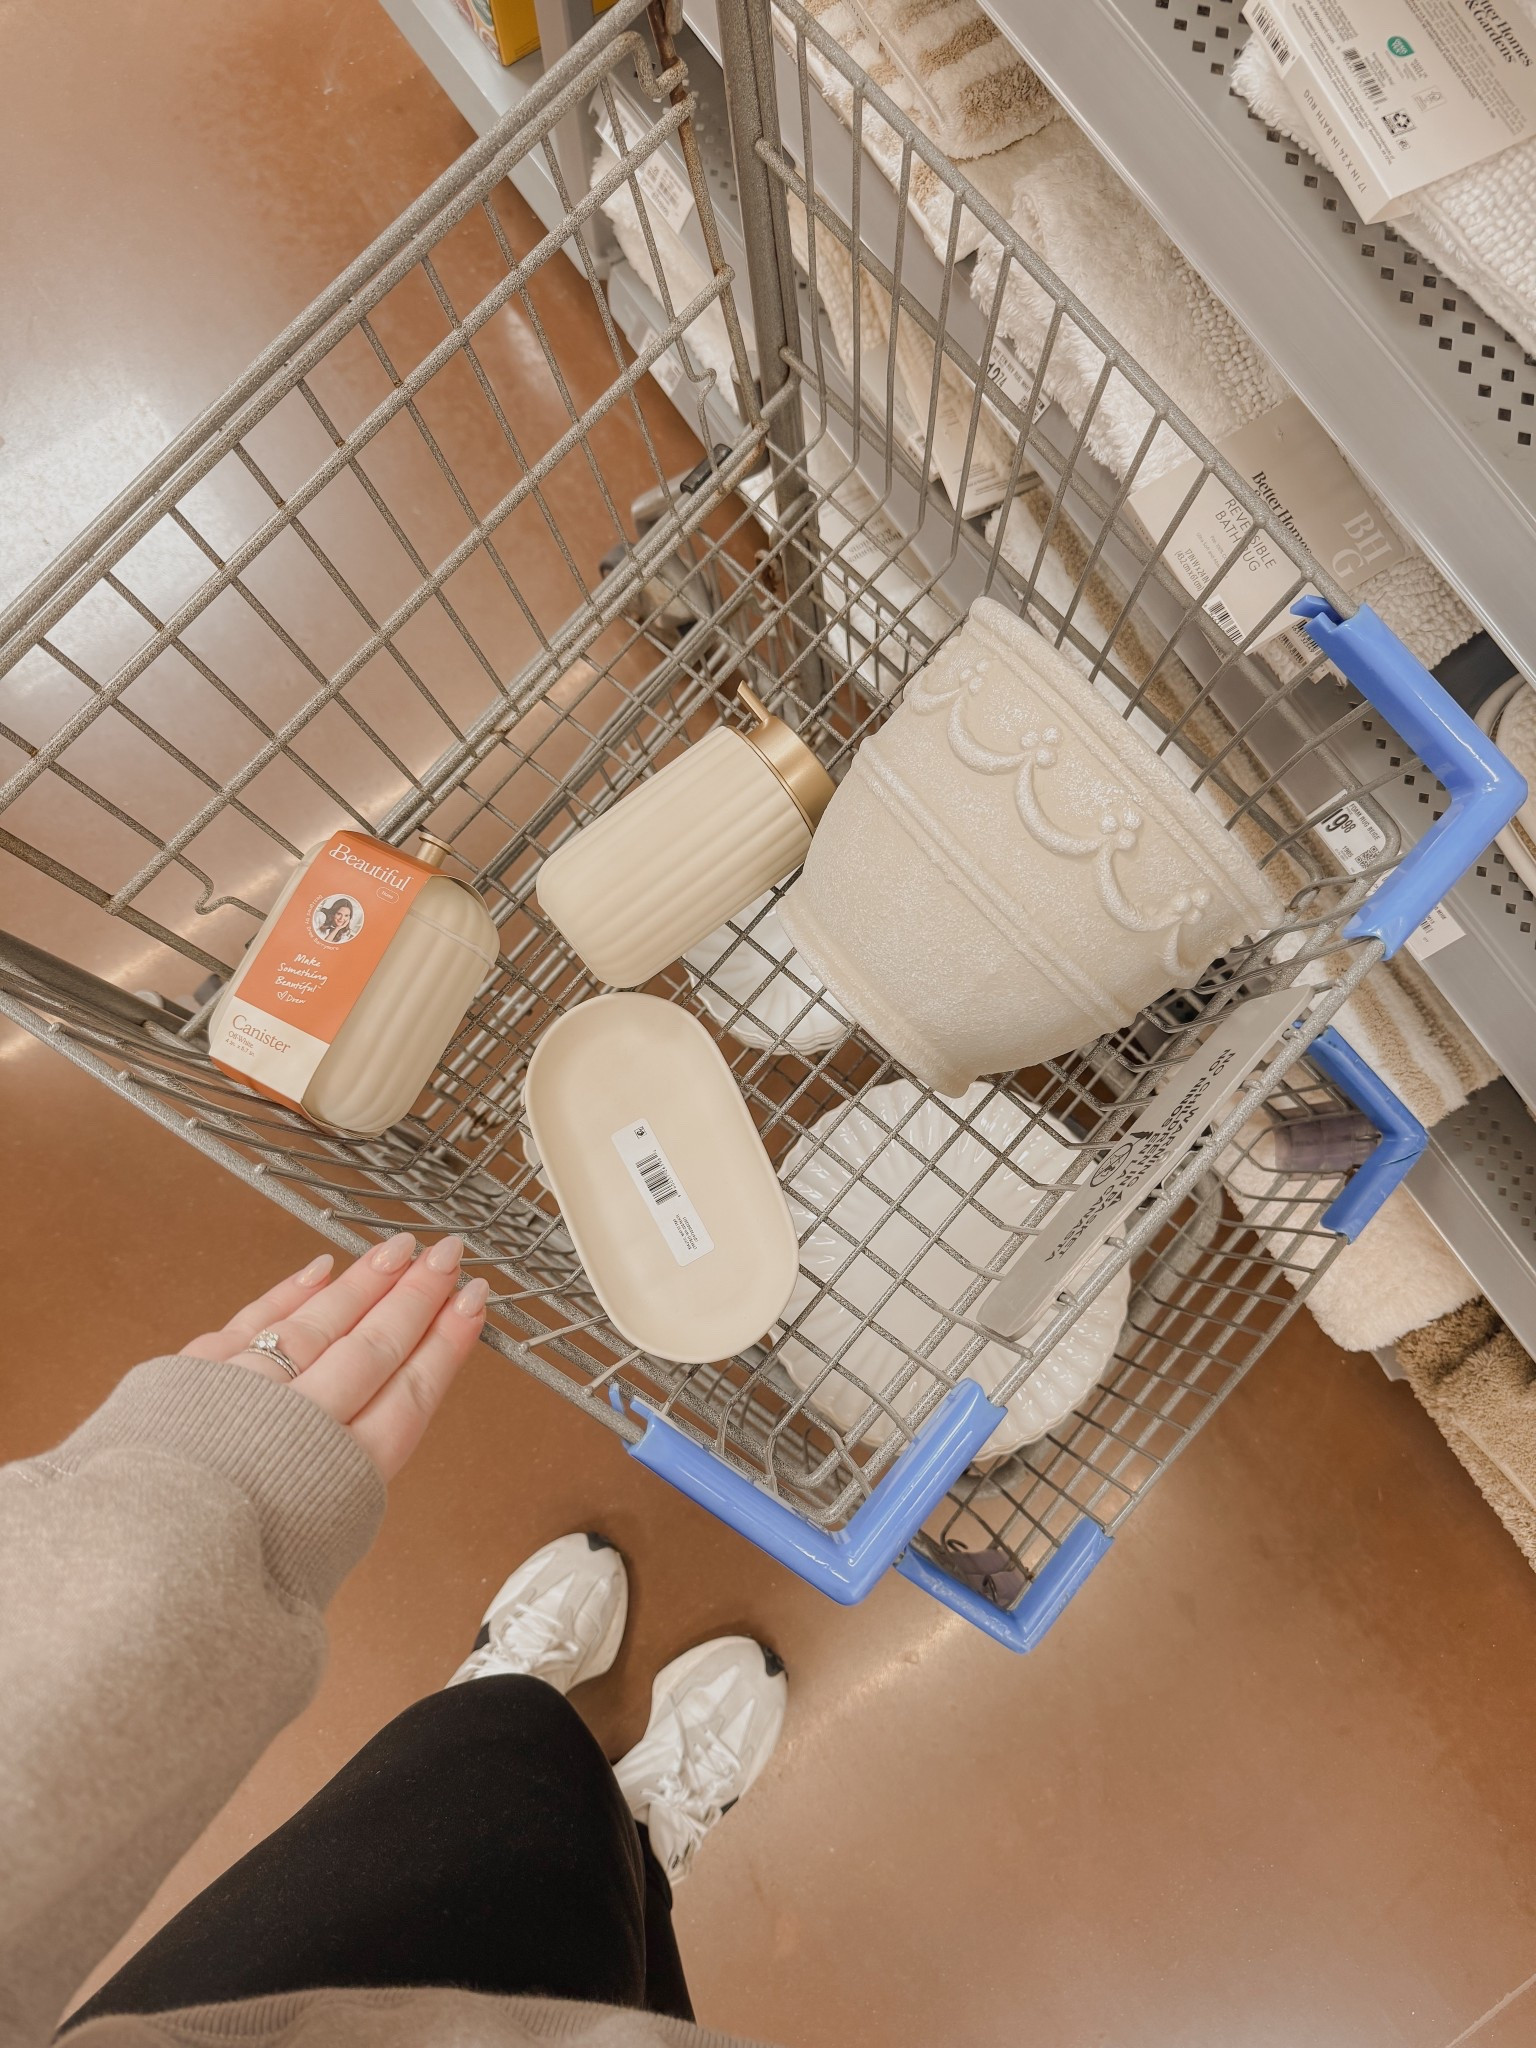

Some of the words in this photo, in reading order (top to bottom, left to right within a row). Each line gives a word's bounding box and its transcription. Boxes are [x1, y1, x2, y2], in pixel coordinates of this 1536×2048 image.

[1474, 9, 1512, 63] Gardens
[1497, 21, 1532, 67] Homes
[1315, 110, 1333, 136] BATH
[1330, 136, 1340, 149] IN
[1350, 169, 1361, 181] IN
[1251, 471, 1283, 511] Better
[1215, 510, 1242, 543] BATH
[1242, 546, 1261, 572] UG
[1224, 498, 1277, 569] REVESIBLE
[1341, 509, 1393, 565] BH
[1359, 816, 1370, 828] RUG
[328, 842, 413, 892] Beautiful
[293, 953, 322, 967] Make
[274, 974, 318, 995] Beautiful
[276, 962, 328, 986] Something
[286, 994, 306, 1004] Drew
[232, 1014, 291, 1054] Canister
[1208, 1048, 1231, 1072] NO
[1212, 1052, 1236, 1076] NO
[1136, 1081, 1210, 1165] CHILDREN
[1127, 1106, 1199, 1187] WARNING
[1138, 1132, 1160, 1155] EN
[1115, 1159, 1138, 1180] LA
[1118, 1169, 1138, 1185] IN
[1044, 1184, 1115, 1262] CANASTA
[1059, 1191, 1118, 1260] BASKET
